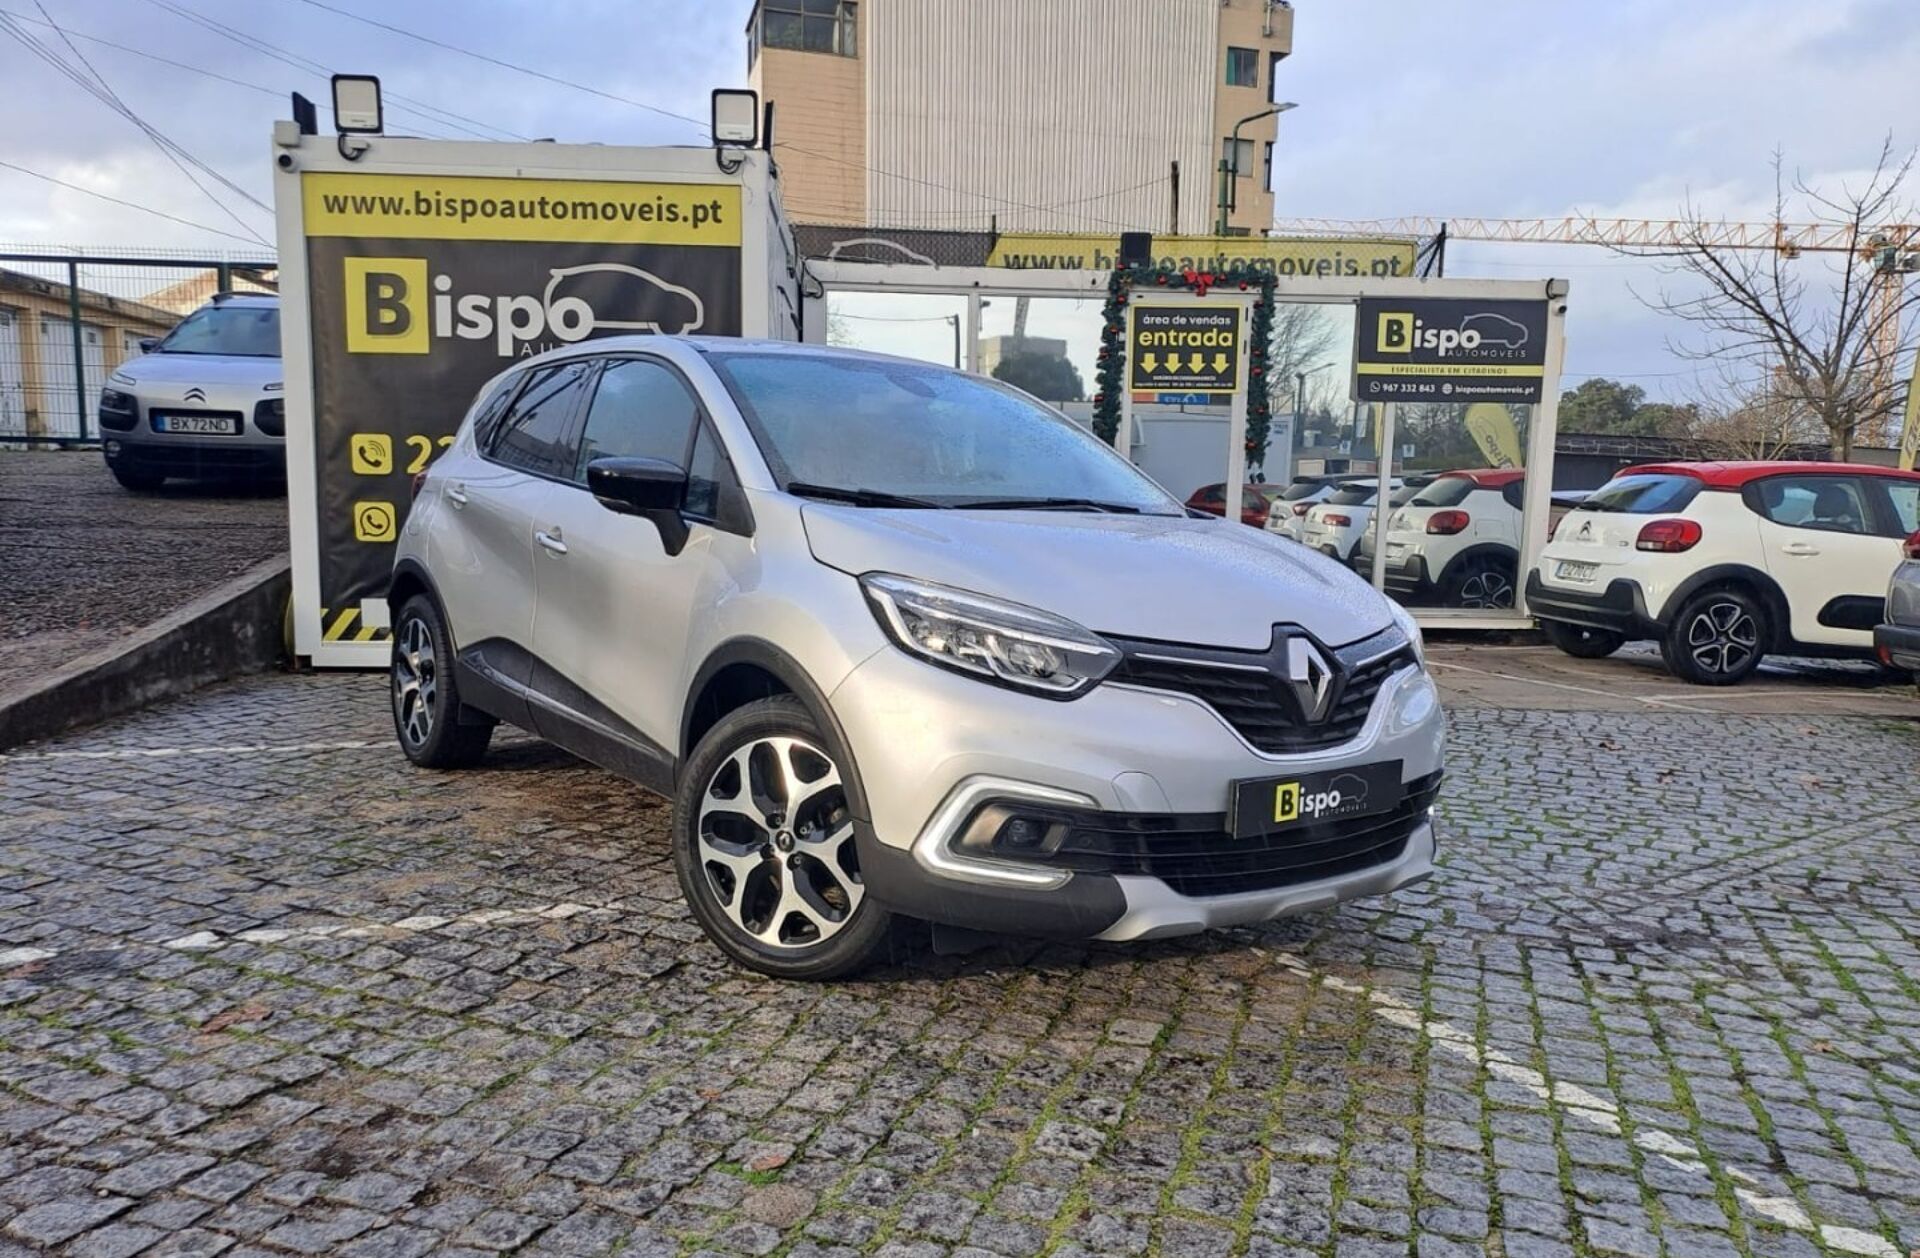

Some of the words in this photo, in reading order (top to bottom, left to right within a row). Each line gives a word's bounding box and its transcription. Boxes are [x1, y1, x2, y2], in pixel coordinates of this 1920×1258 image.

[322, 190, 724, 229] www.bispoautomoveis.pt
[364, 271, 595, 357] Bispo
[1143, 313, 1170, 325] área
[1172, 314, 1187, 325] de
[1189, 314, 1231, 325] vendas
[1138, 327, 1233, 346] entrada
[1385, 318, 1482, 357] Bispo
[1447, 350, 1526, 358] AUTOMOVEIS
[1391, 366, 1445, 374] ESPECIALISTA
[1463, 367, 1508, 375] CITADINOS
[1382, 383, 1398, 393] 967
[1400, 383, 1417, 393] 332
[1455, 385, 1535, 395] bispoautomoveis.pt
[1280, 787, 1341, 818] Bispo
